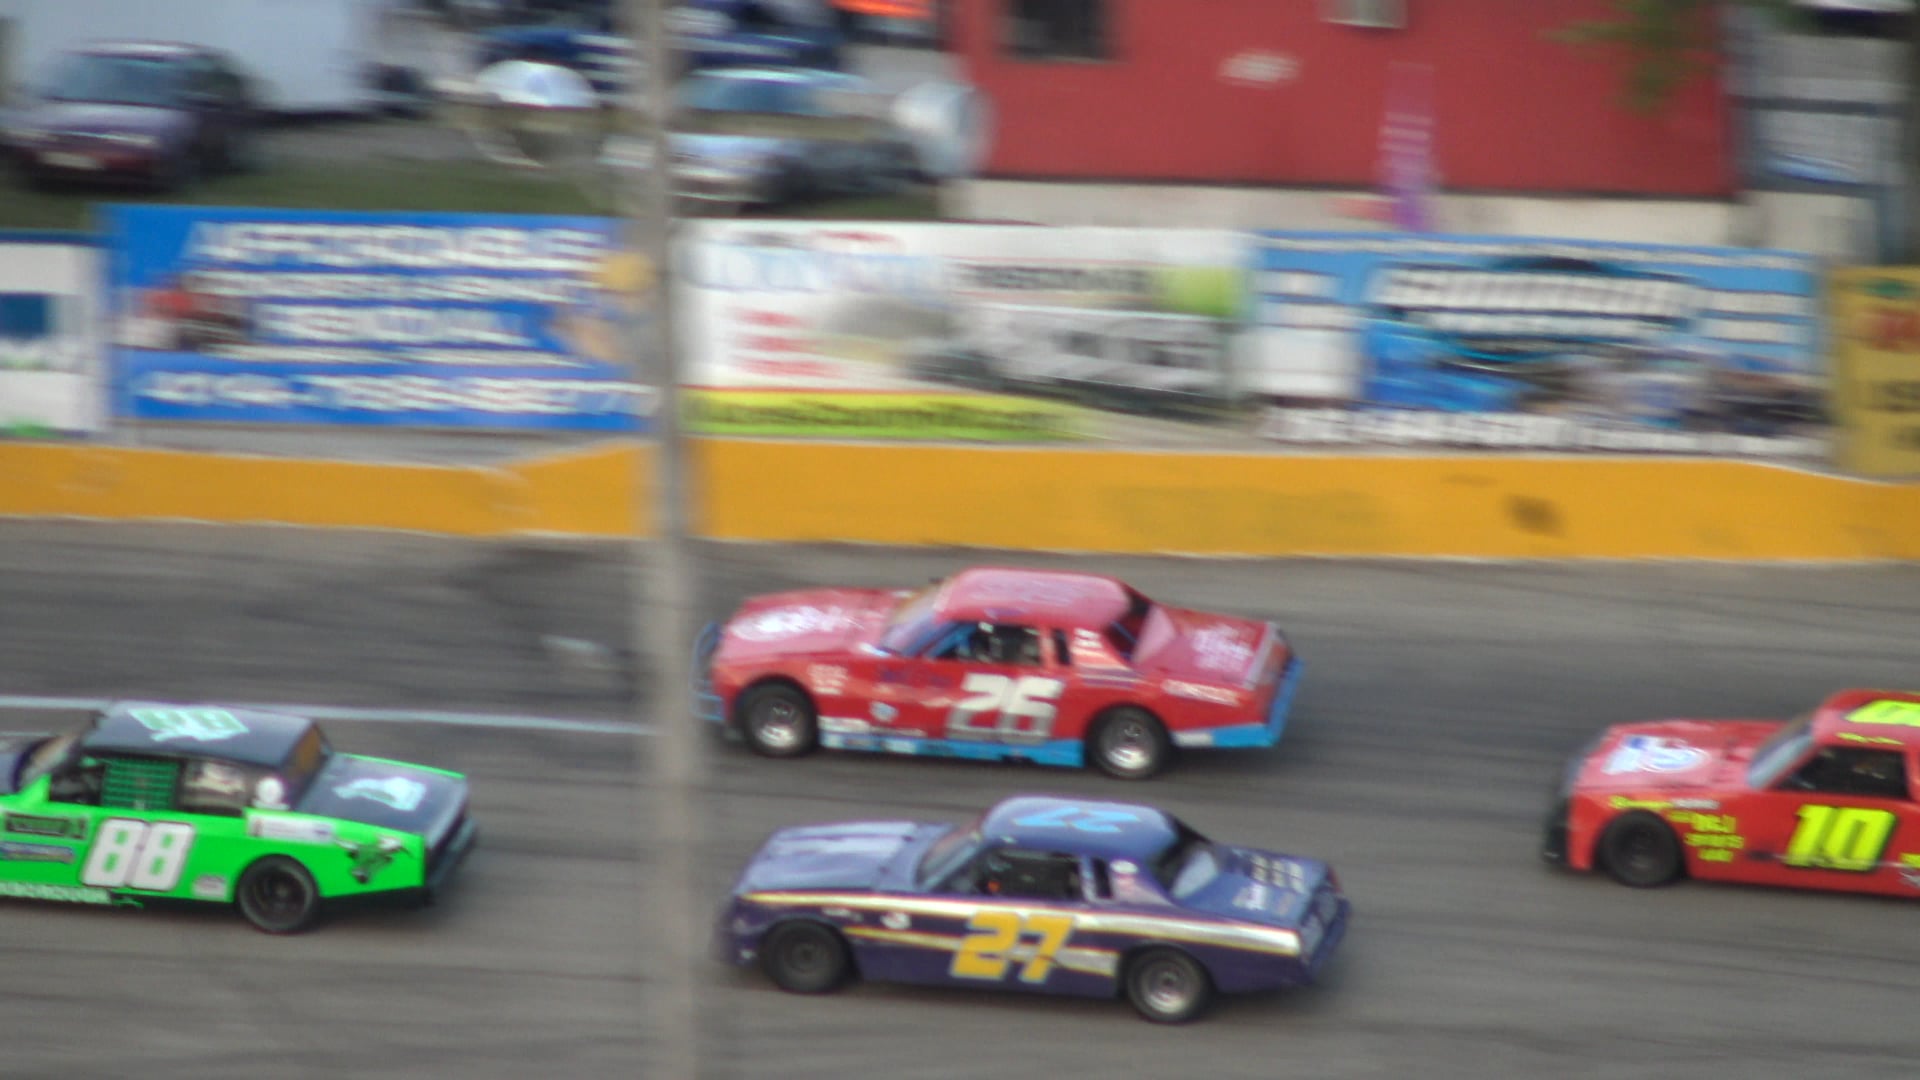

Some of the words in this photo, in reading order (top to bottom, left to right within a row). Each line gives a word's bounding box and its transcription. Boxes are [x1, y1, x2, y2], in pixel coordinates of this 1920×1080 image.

[947, 672, 1066, 743] 26
[80, 817, 195, 891] 88
[1785, 803, 1897, 872] 10
[949, 909, 1076, 984] 27
